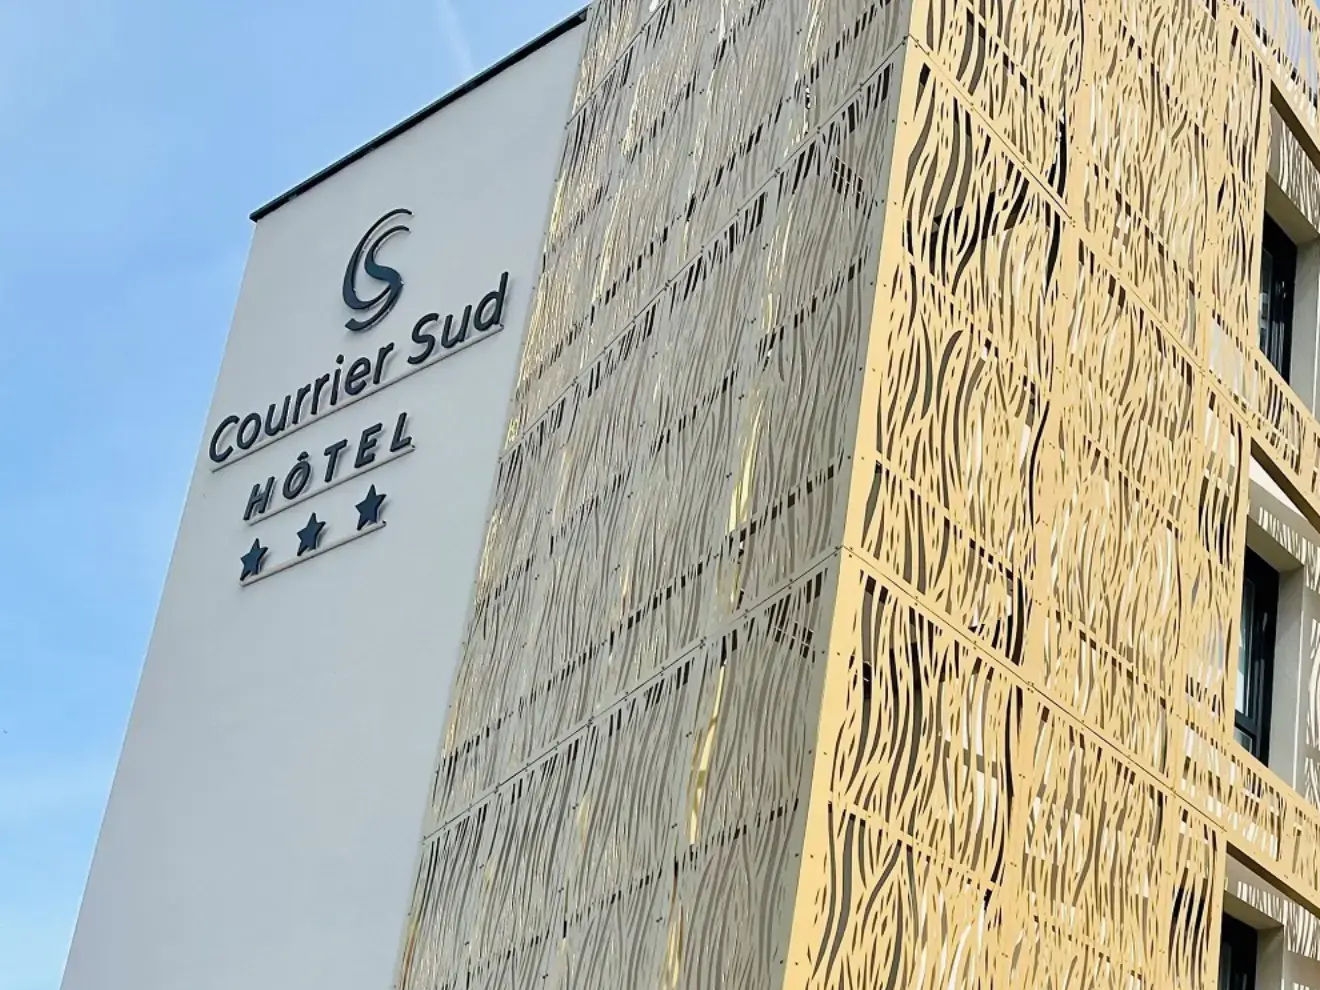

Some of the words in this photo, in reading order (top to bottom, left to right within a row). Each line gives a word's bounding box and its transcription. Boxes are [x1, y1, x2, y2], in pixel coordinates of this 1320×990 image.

[209, 342, 394, 463] Courrier
[407, 271, 509, 365] Sud
[243, 412, 412, 521] HÔTEL
